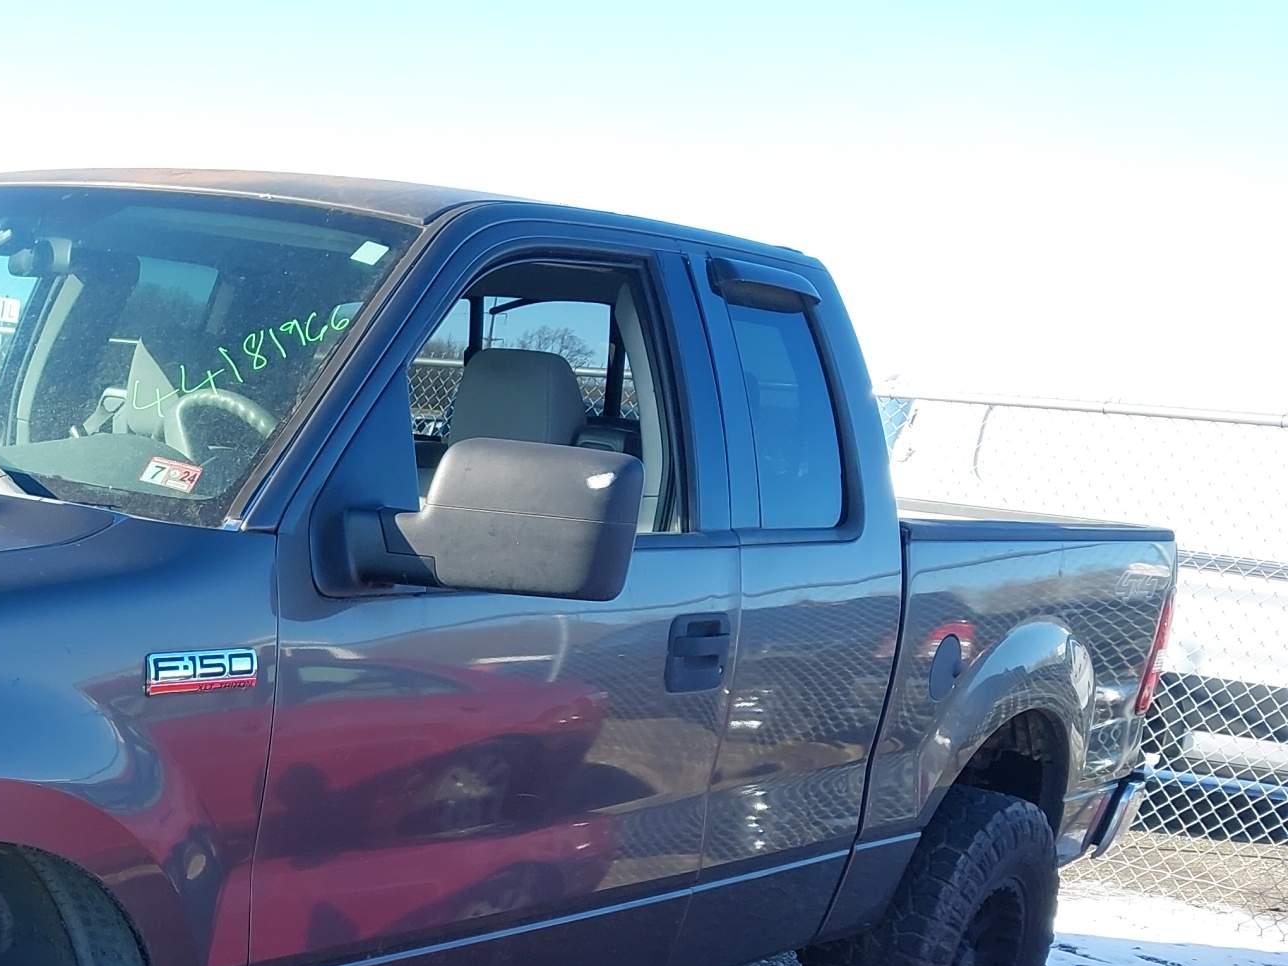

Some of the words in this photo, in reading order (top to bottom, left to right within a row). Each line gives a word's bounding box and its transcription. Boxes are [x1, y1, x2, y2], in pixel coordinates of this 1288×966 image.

[150, 464, 167, 480] 7
[179, 470, 198, 484] 24
[153, 653, 254, 681] F-150
